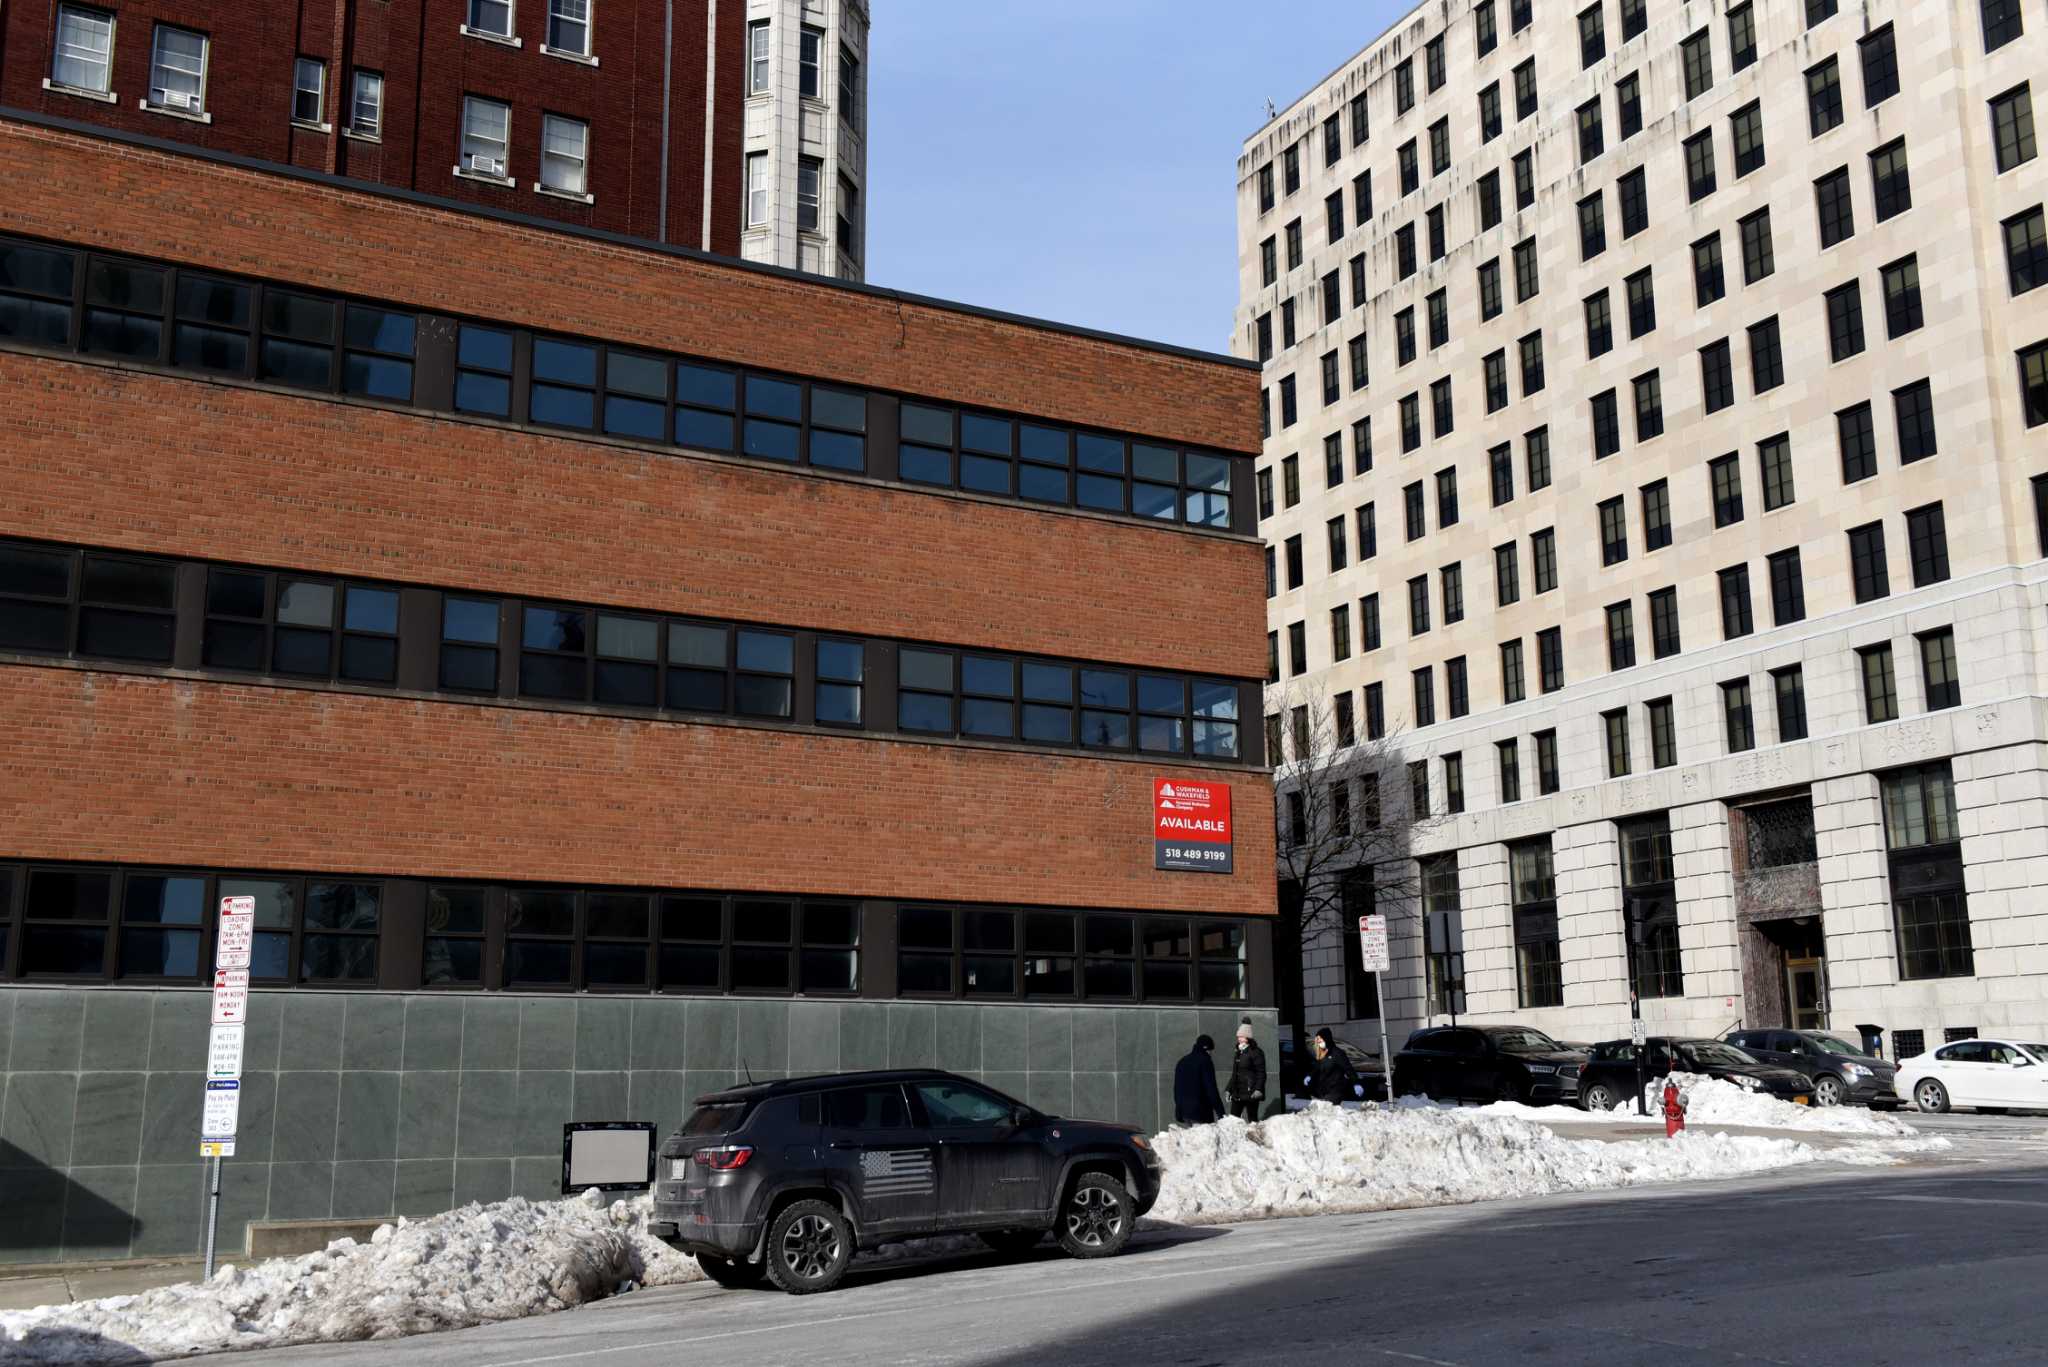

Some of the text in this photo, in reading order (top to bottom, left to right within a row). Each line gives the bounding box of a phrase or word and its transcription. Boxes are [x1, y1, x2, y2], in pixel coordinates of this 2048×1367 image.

[1176, 786, 1204, 794] CUSHMAN
[1160, 816, 1225, 832] AVAILABLE
[1165, 848, 1226, 861] 518 489 9199
[232, 903, 253, 911] PARKING
